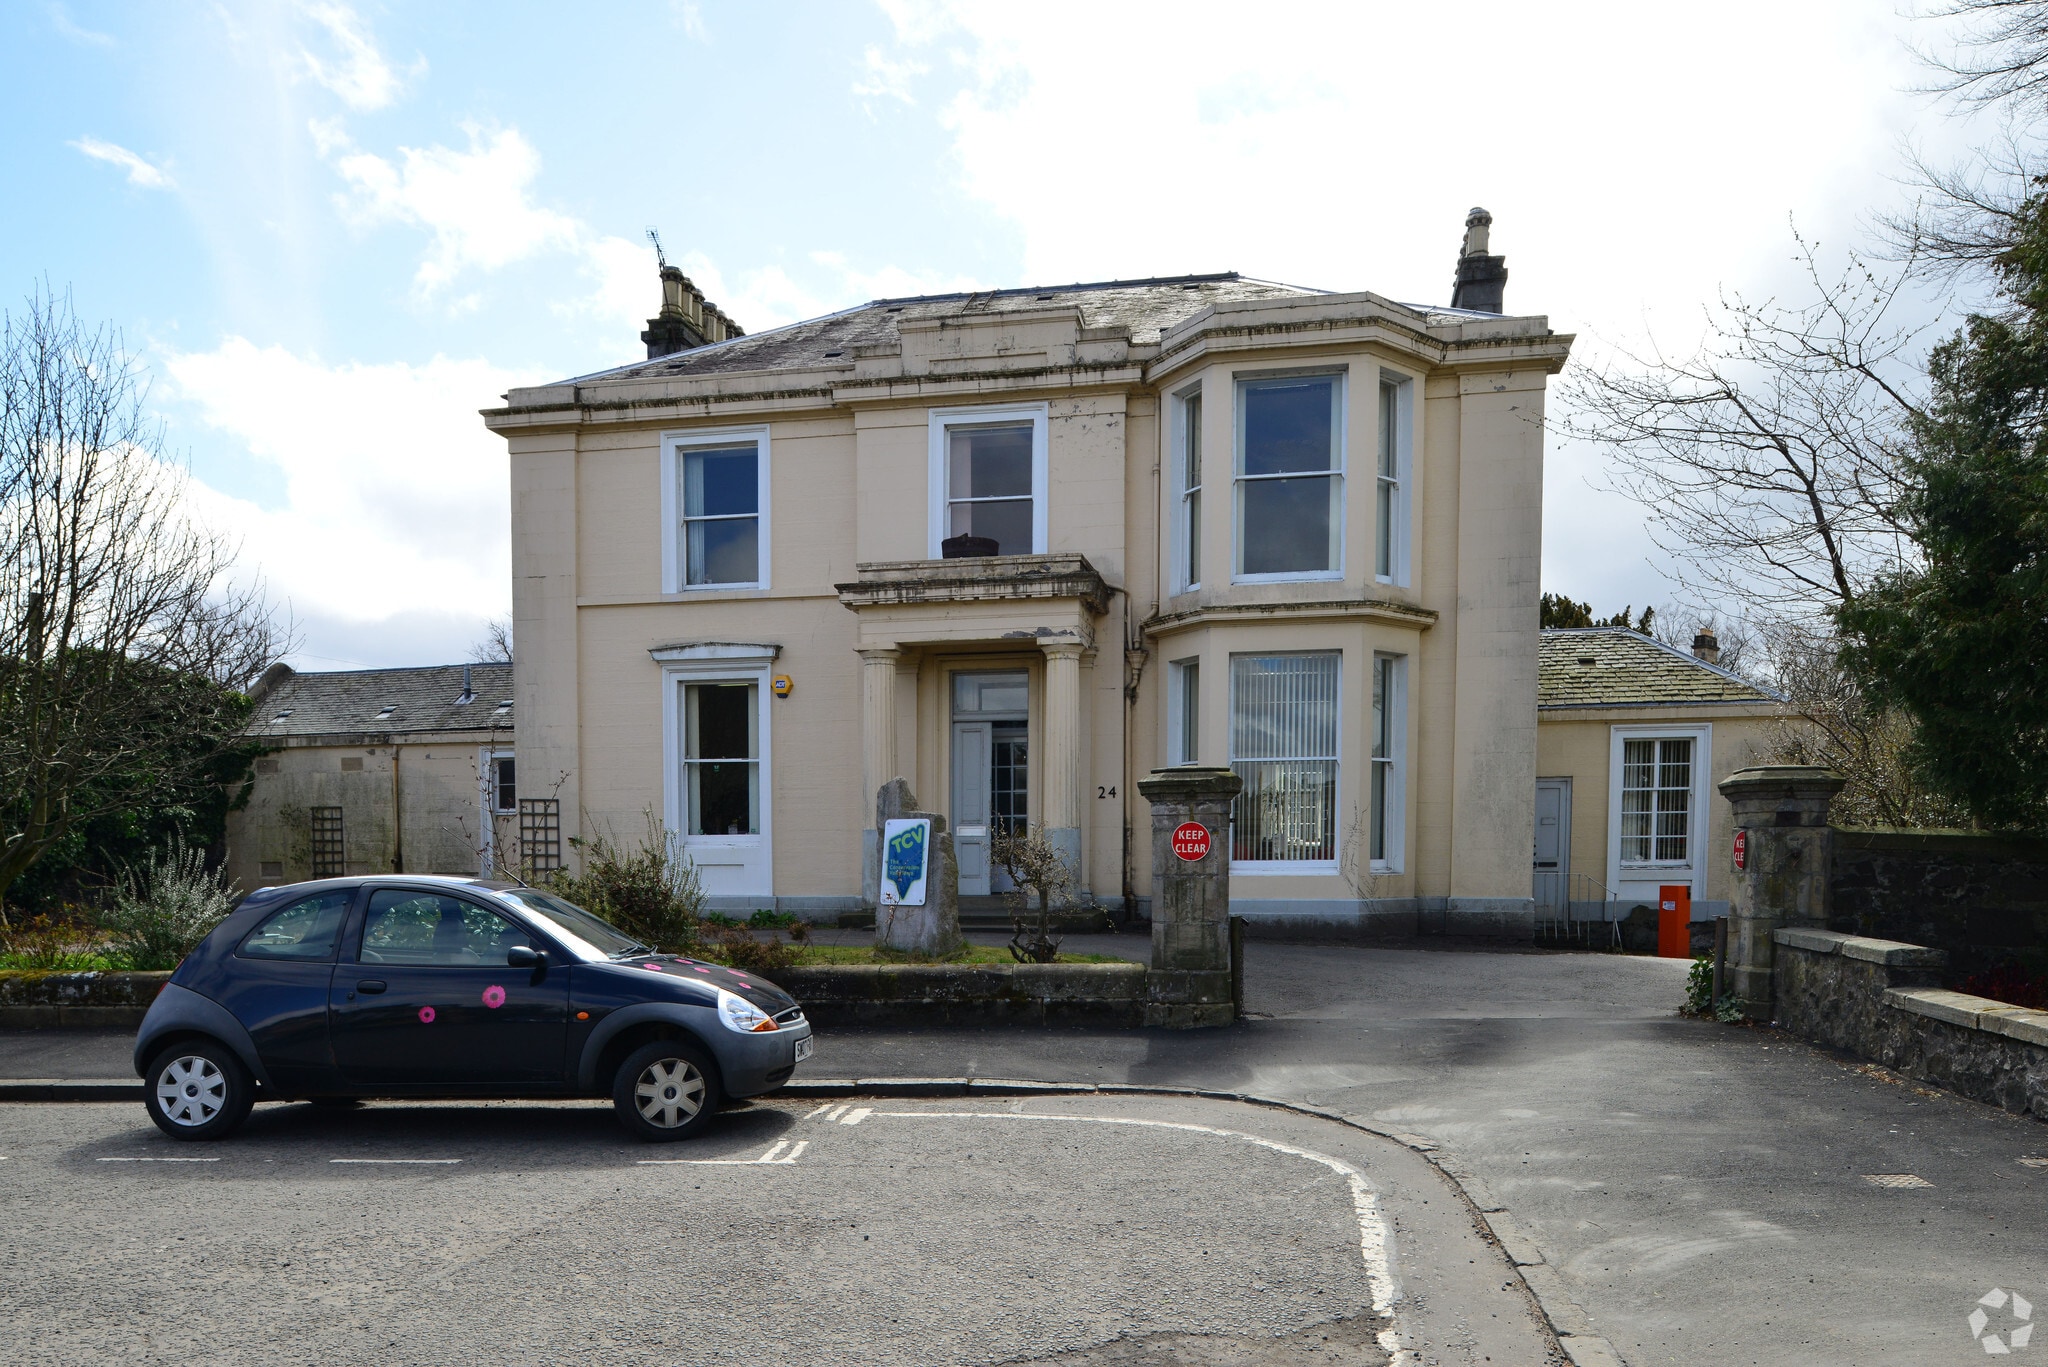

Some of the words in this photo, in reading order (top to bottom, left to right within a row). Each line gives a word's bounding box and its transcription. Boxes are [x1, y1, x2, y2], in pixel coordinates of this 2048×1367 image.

[1098, 786, 1117, 799] 24
[891, 827, 923, 853] TCV
[1178, 830, 1204, 840] KEEP
[1175, 843, 1206, 853] CLEAR
[1736, 839, 1744, 848] KE
[1734, 852, 1744, 861] CLE
